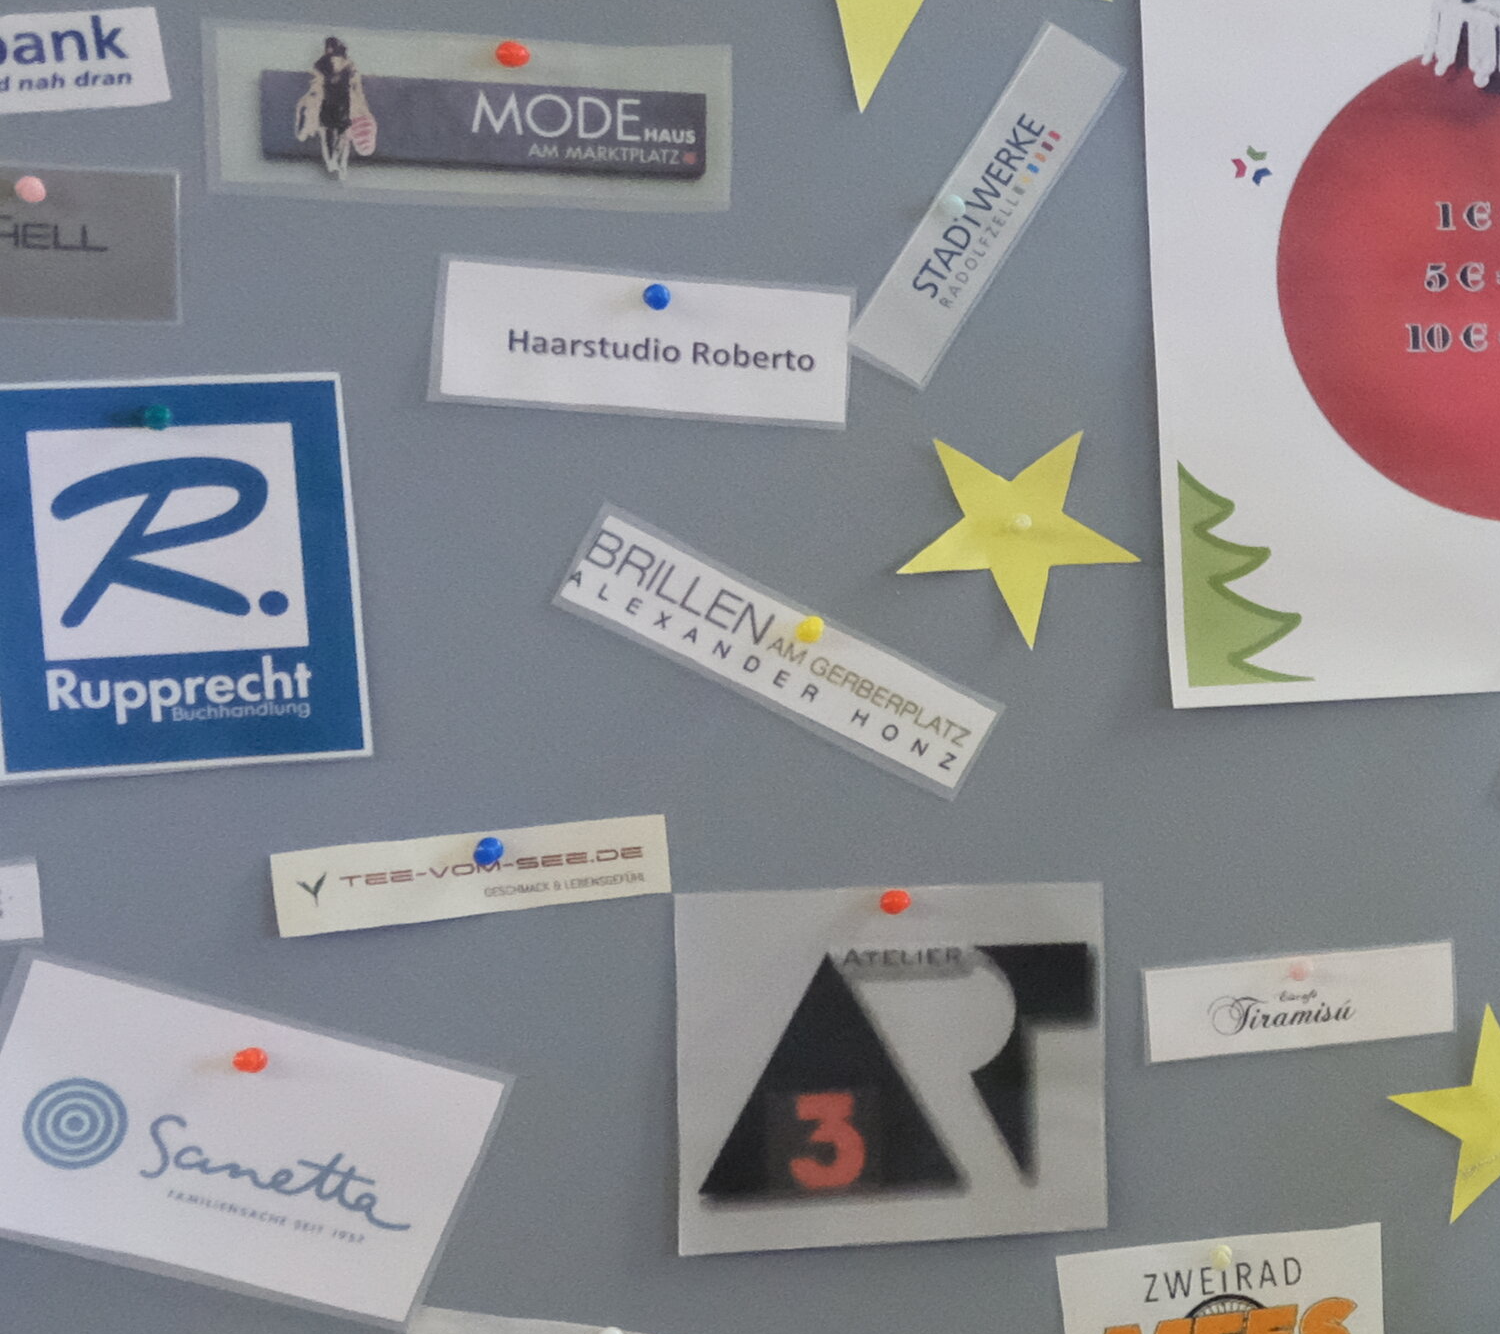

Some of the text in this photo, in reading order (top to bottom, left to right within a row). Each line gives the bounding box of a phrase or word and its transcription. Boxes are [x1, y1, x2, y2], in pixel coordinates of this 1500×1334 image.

[0, 15, 129, 66] ank
[19, 72, 65, 91] nah
[75, 71, 132, 88] dran
[472, 90, 697, 145] MODE HAUS
[528, 142, 682, 165] AM MARKTPLATZ
[1435, 201, 1456, 232] 1
[1462, 201, 1492, 232] €
[1424, 262, 1449, 293] 5
[1455, 262, 1486, 292] €
[507, 328, 817, 373] Haarstudio Roberto
[1405, 323, 1452, 353] 10
[1459, 323, 1488, 352] €
[585, 528, 973, 749] BRILLEN AM GERBERPLATZ
[45, 655, 312, 725] Rupprecht
[568, 569, 958, 770] ALEXANDER HONZ
[172, 701, 312, 723] Buchhandlung
[842, 946, 963, 968] ATELIER
[789, 1091, 867, 1190] 3
[139, 1114, 412, 1231] Sanetta
[1143, 1257, 1303, 1303] ZWEIRAD
